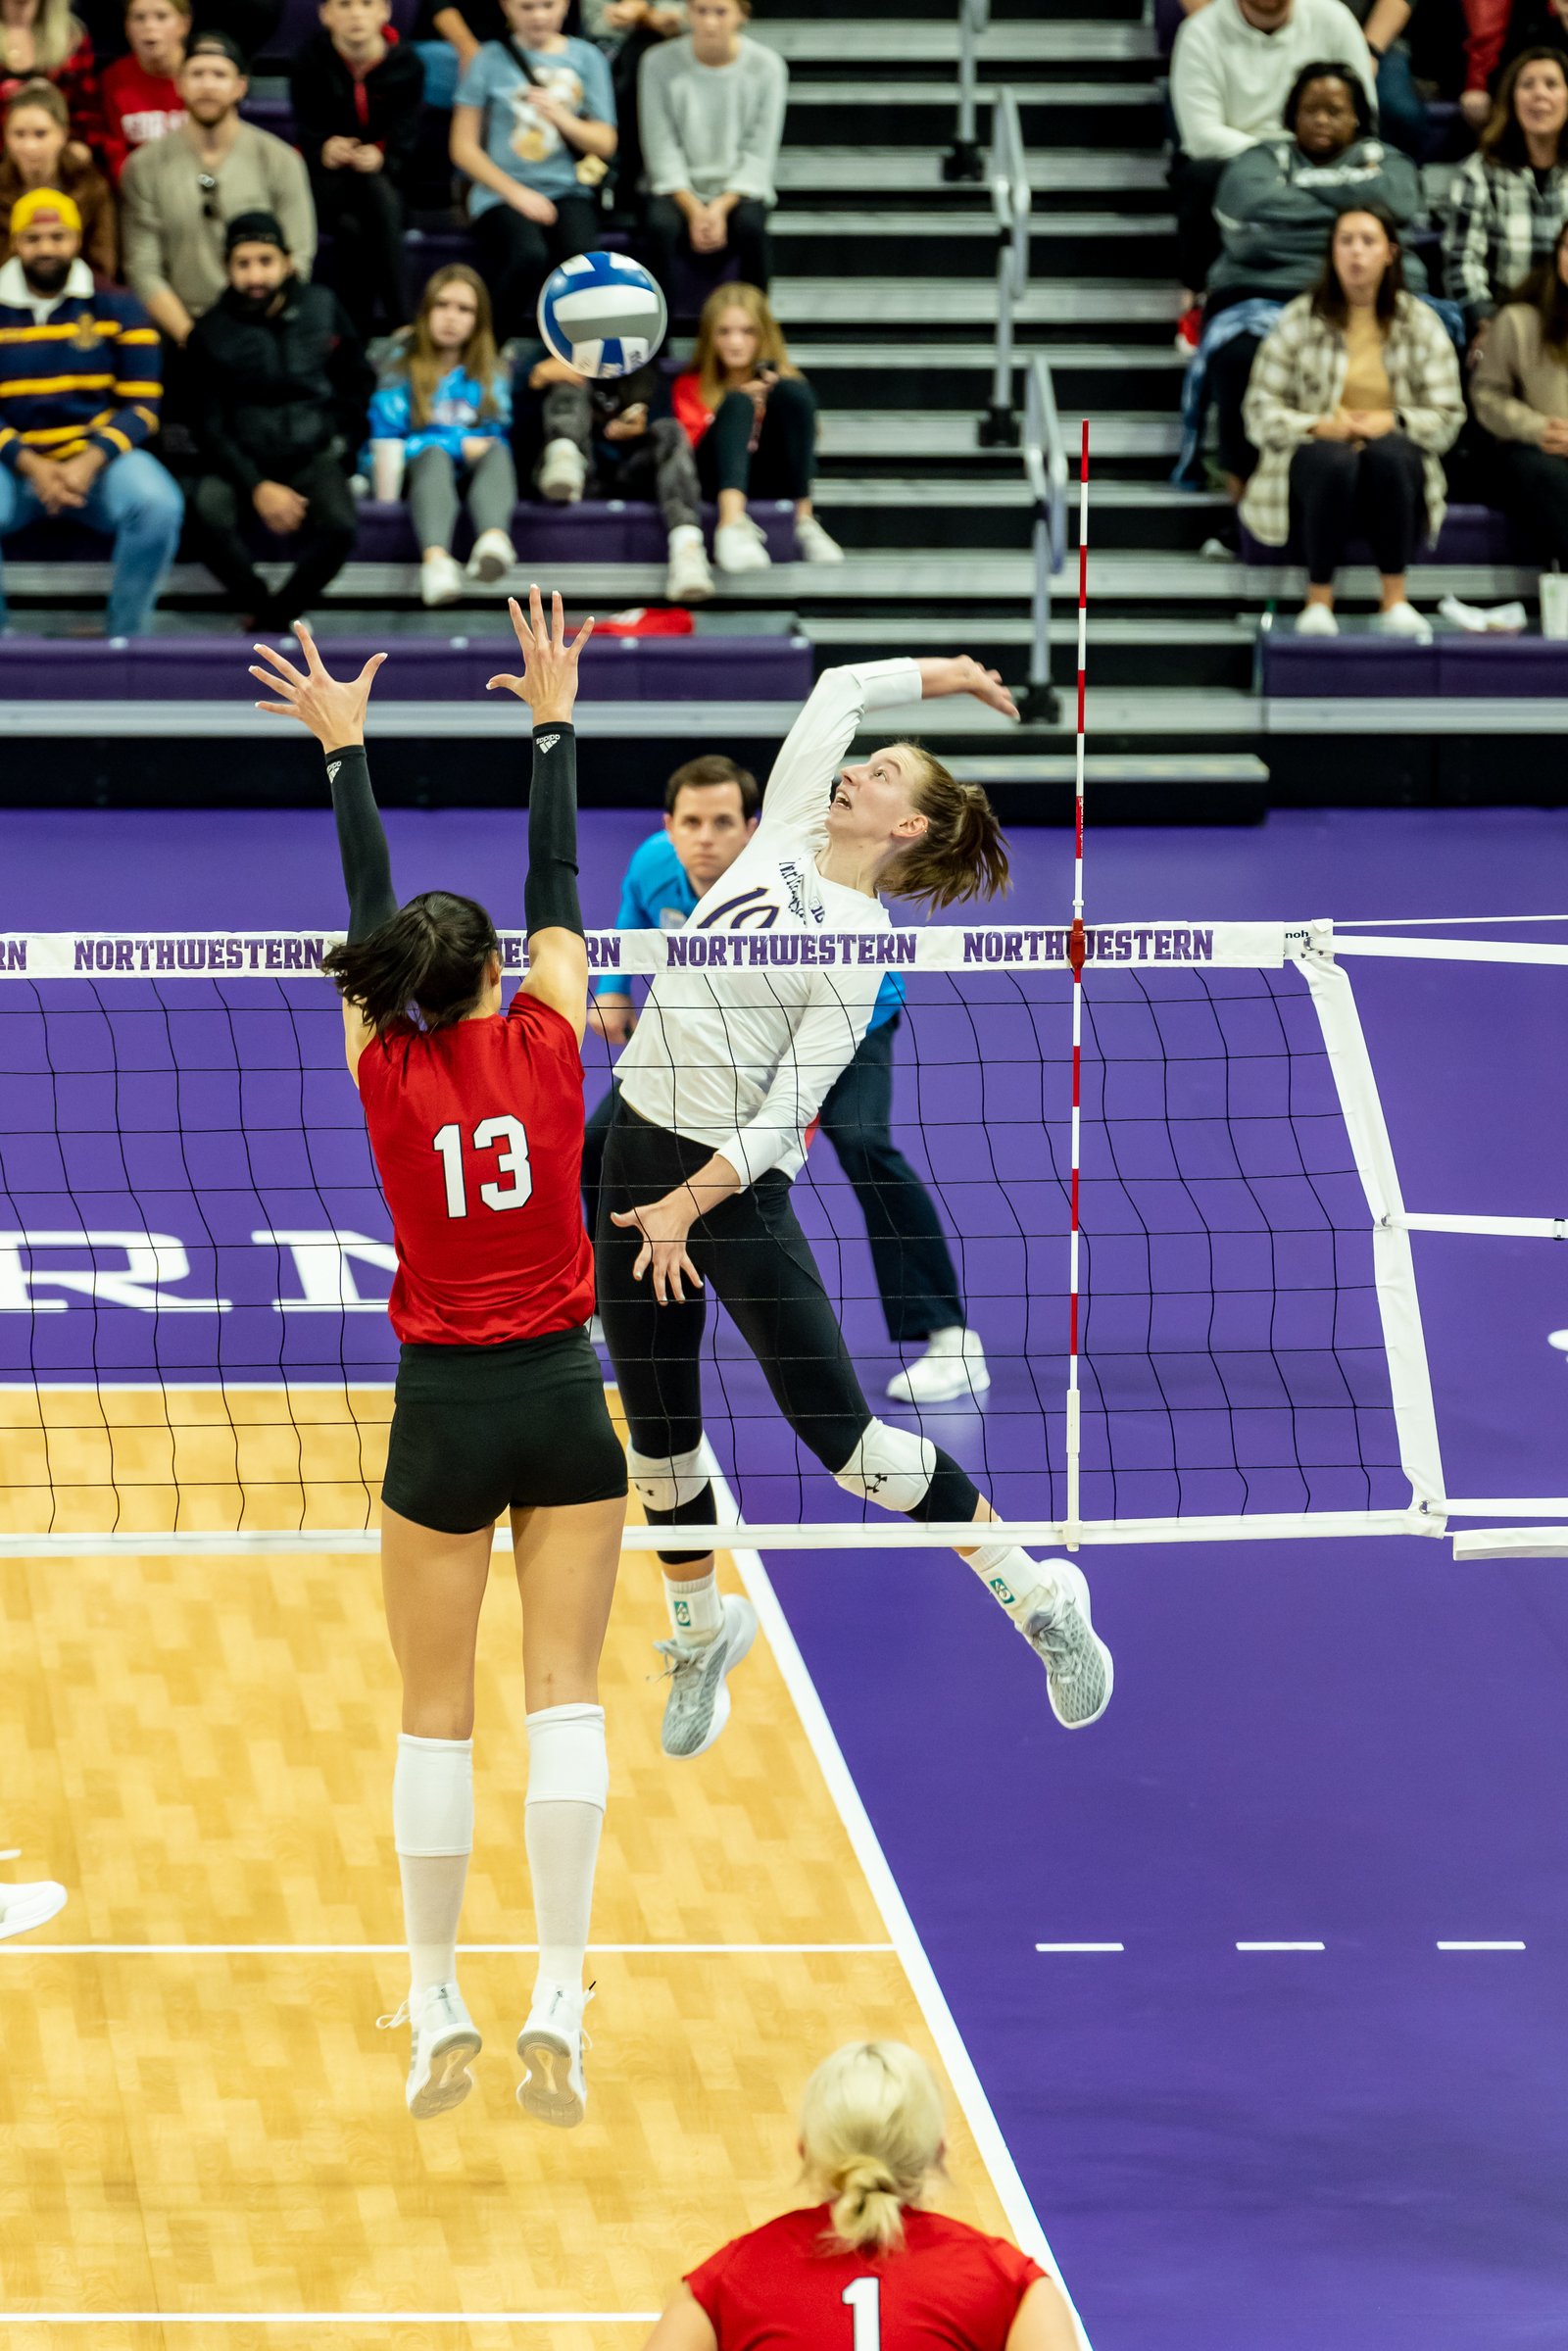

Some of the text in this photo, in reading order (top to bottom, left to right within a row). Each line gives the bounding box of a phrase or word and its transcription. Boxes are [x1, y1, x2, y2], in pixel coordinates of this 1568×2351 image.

[74, 939, 324, 970] NORTHWESTERN
[666, 934, 917, 967] NORTHWESTERN
[432, 1114, 533, 1218] 13
[841, 2276, 881, 2351] 1
